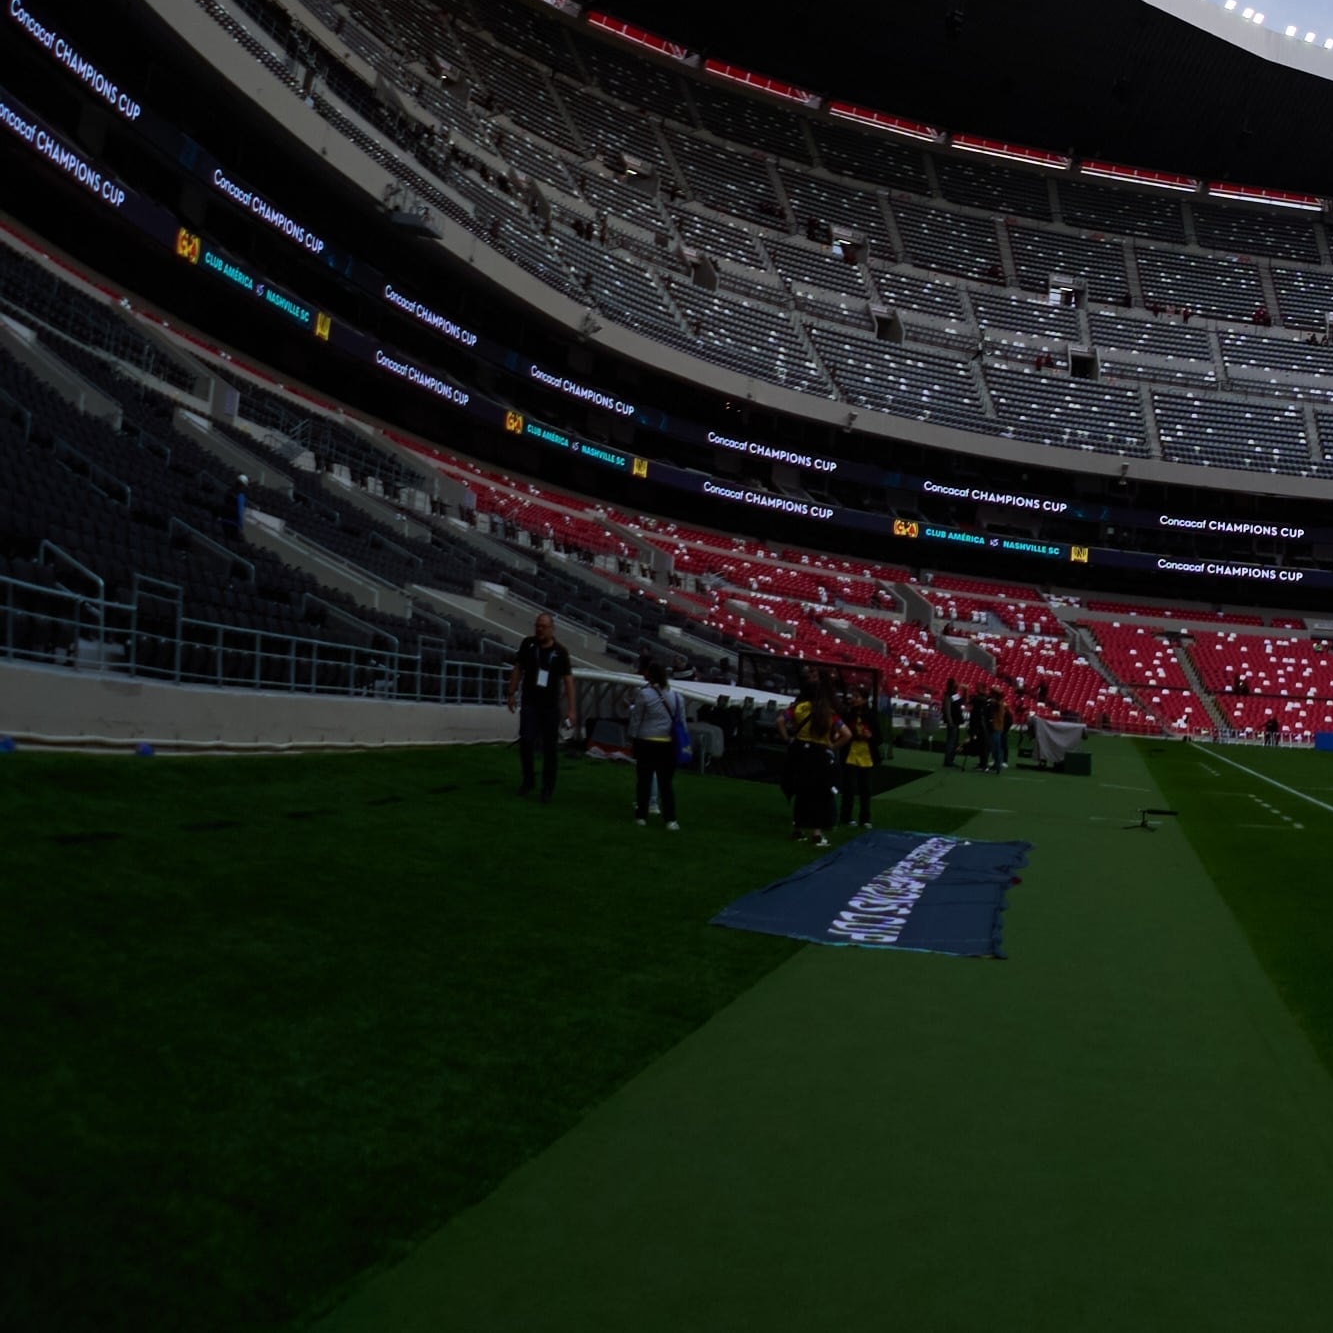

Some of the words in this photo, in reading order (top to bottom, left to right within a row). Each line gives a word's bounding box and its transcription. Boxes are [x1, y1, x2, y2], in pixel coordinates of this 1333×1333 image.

[56, 39, 117, 103] CHAMPIONS
[119, 94, 140, 120] CUP
[0, 104, 36, 141] oncacaf
[37, 131, 101, 191] CHAMPIONS
[102, 181, 124, 206] CUP
[214, 169, 251, 206] Concacaf
[252, 197, 304, 242] CHAMPIONS
[306, 233, 323, 253] CUP
[205, 252, 223, 271] CLUB
[266, 290, 299, 317] NASHVILLE
[385, 285, 415, 312] Concacaf
[416, 305, 460, 338] CHAMPIONS
[461, 330, 477, 346] CUP
[377, 350, 408, 375] Concacaf
[409, 367, 452, 398] CHAMPIONS
[453, 390, 469, 405] CUP
[531, 365, 562, 387] Concacaf
[563, 380, 614, 409] CHAMPIONS
[616, 402, 634, 415] CUP
[527, 424, 541, 436] CLUB
[581, 445, 615, 463] NASHVILLE
[708, 432, 747, 450] Concacaf
[749, 443, 811, 466] CHAMPIONS
[814, 459, 837, 471] CUP
[704, 482, 744, 499] Concacaf
[745, 492, 808, 514] CHAMPIONS
[810, 507, 833, 518] CUP
[924, 481, 969, 497] Concacaf
[972, 490, 1040, 508] CHAMPIONS
[1043, 501, 1067, 512] CUP
[926, 528, 946, 538] CLUB
[948, 532, 985, 544] AMÉRICA
[1003, 541, 1046, 553] NASHVILLE
[1047, 547, 1059, 555] SC
[1160, 516, 1206, 528] Concacaf
[1209, 521, 1277, 536] CHAMPIONS
[1281, 528, 1304, 538] CUP
[1158, 559, 1204, 572] Concacaf
[1207, 564, 1276, 579] CHAMPIONS
[1279, 571, 1303, 581] CUP
